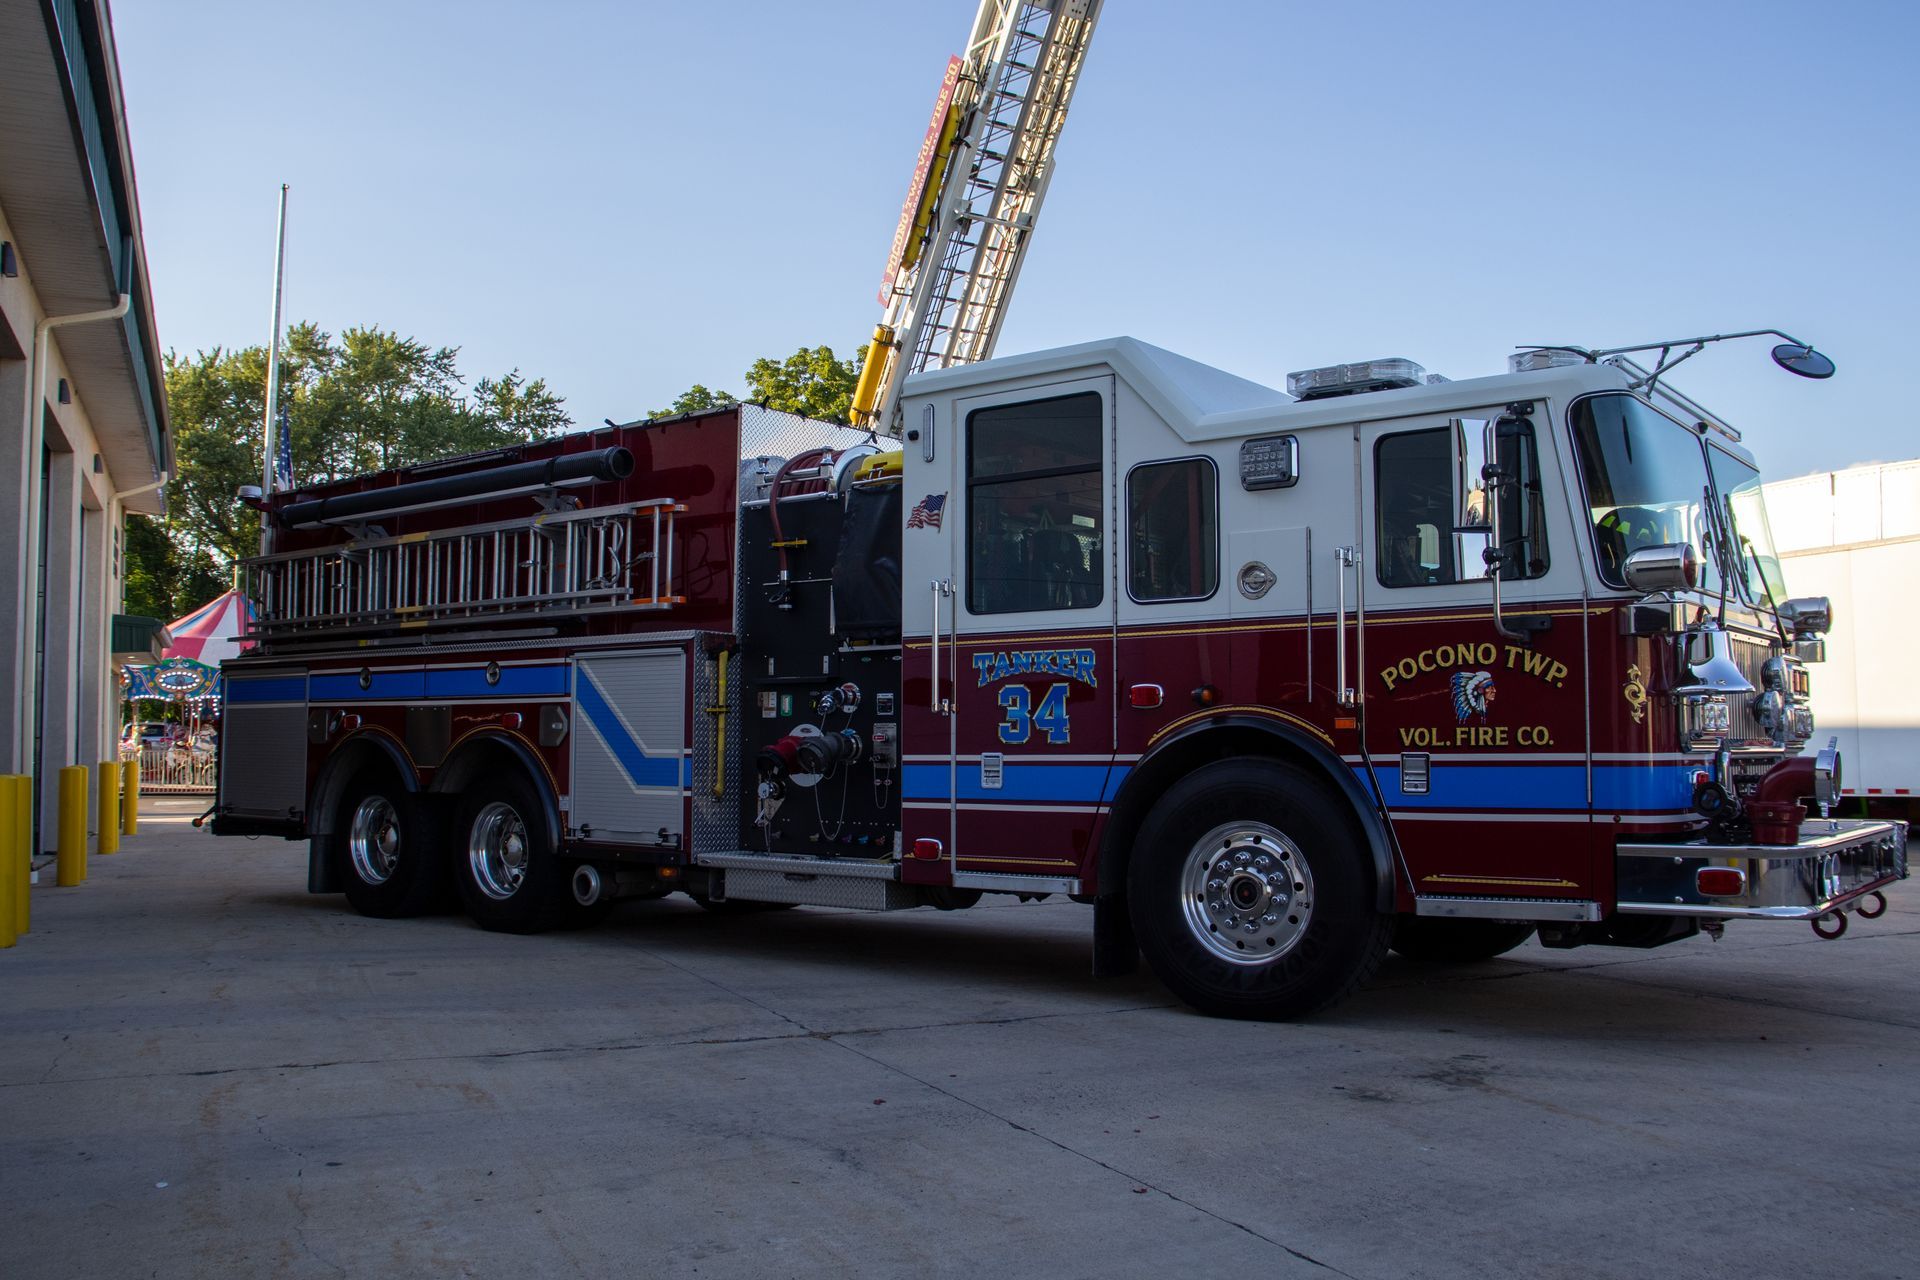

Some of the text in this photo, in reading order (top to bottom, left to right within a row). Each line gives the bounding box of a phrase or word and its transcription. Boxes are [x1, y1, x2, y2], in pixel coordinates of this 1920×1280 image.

[885, 213, 908, 278] POCONO
[918, 132, 934, 167] VOL.
[930, 86, 949, 128] FIRE
[943, 62, 960, 86] CO.
[973, 648, 1097, 688] TANKER
[1380, 643, 1568, 691] POCONO TWP.
[998, 683, 1070, 744] 34
[1399, 726, 1554, 746] VOL. FIRE CO.
